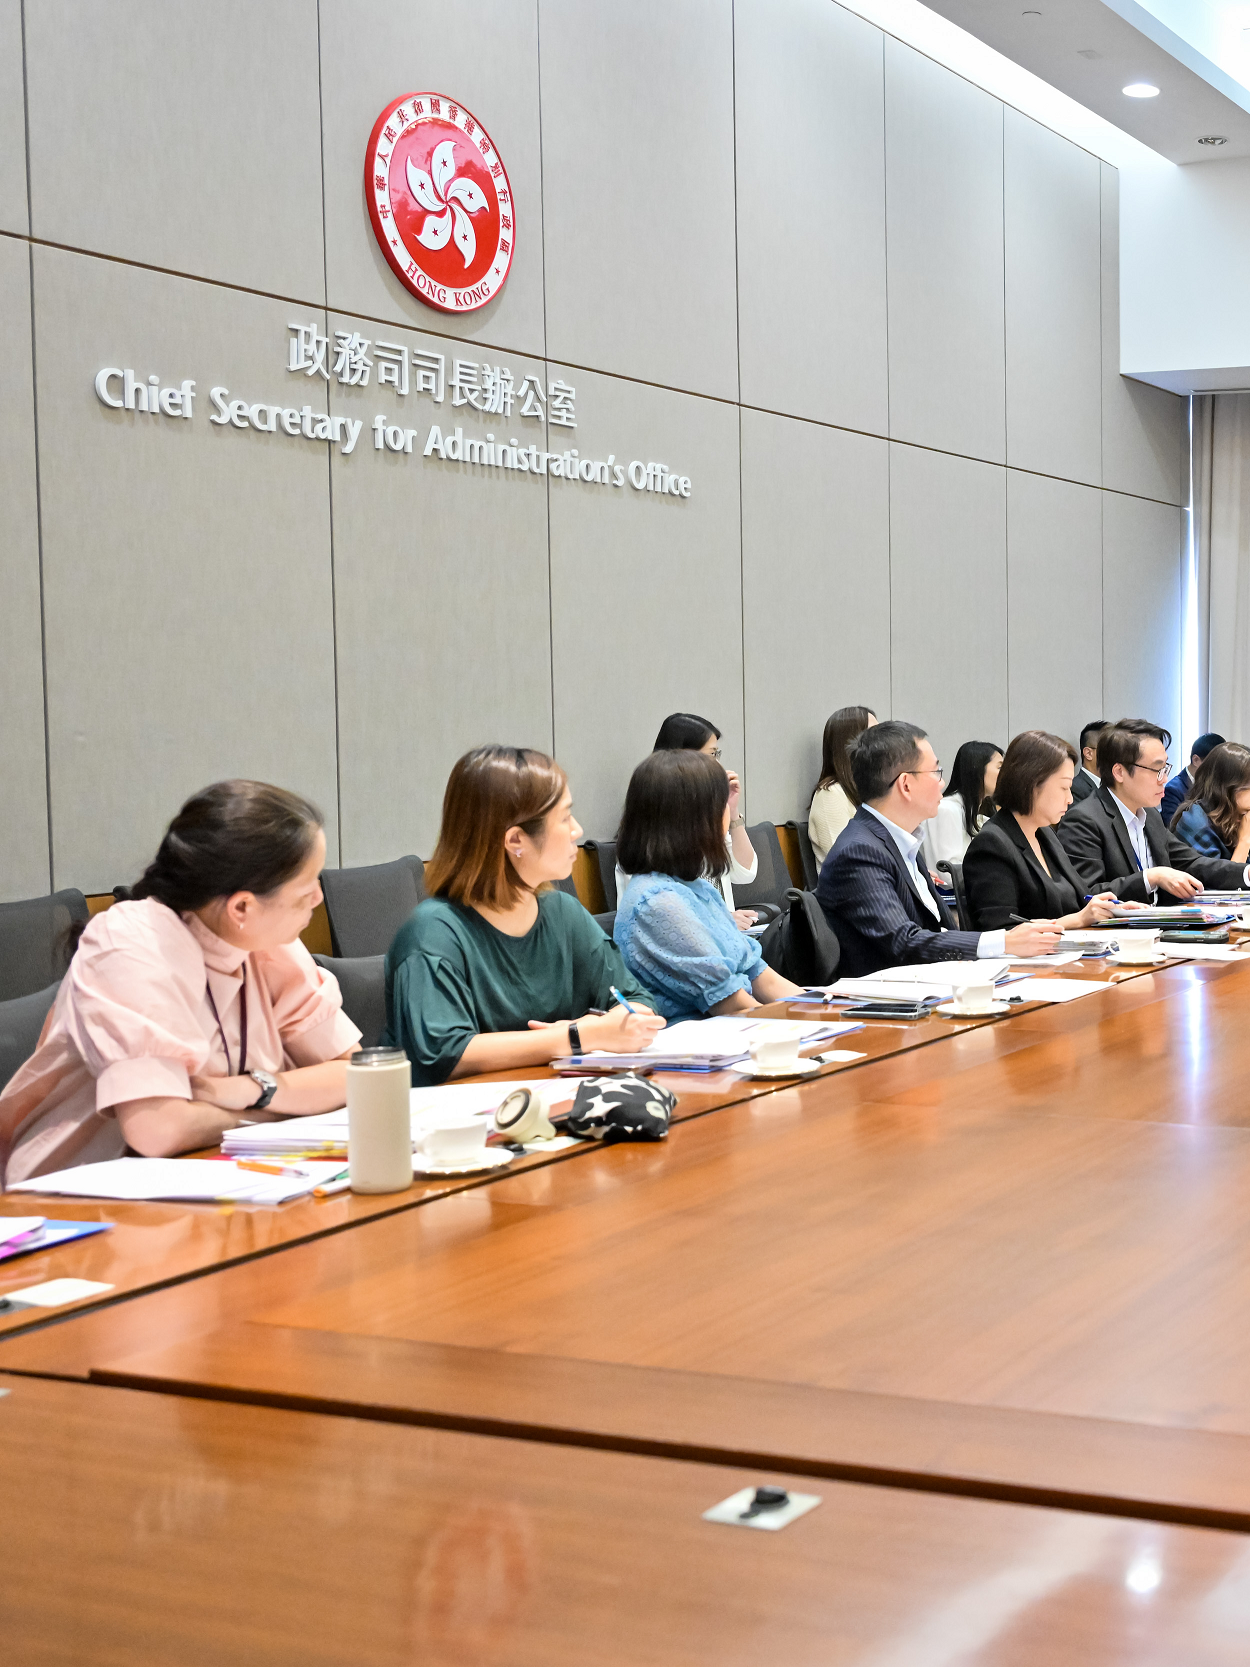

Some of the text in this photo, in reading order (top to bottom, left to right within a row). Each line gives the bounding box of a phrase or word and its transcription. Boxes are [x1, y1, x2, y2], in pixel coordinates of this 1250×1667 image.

[405, 260, 491, 307] HONG KONG
[286, 322, 578, 428] 政務司司長辦公室
[95, 367, 692, 498] Chief Secretary for Administration's Office
